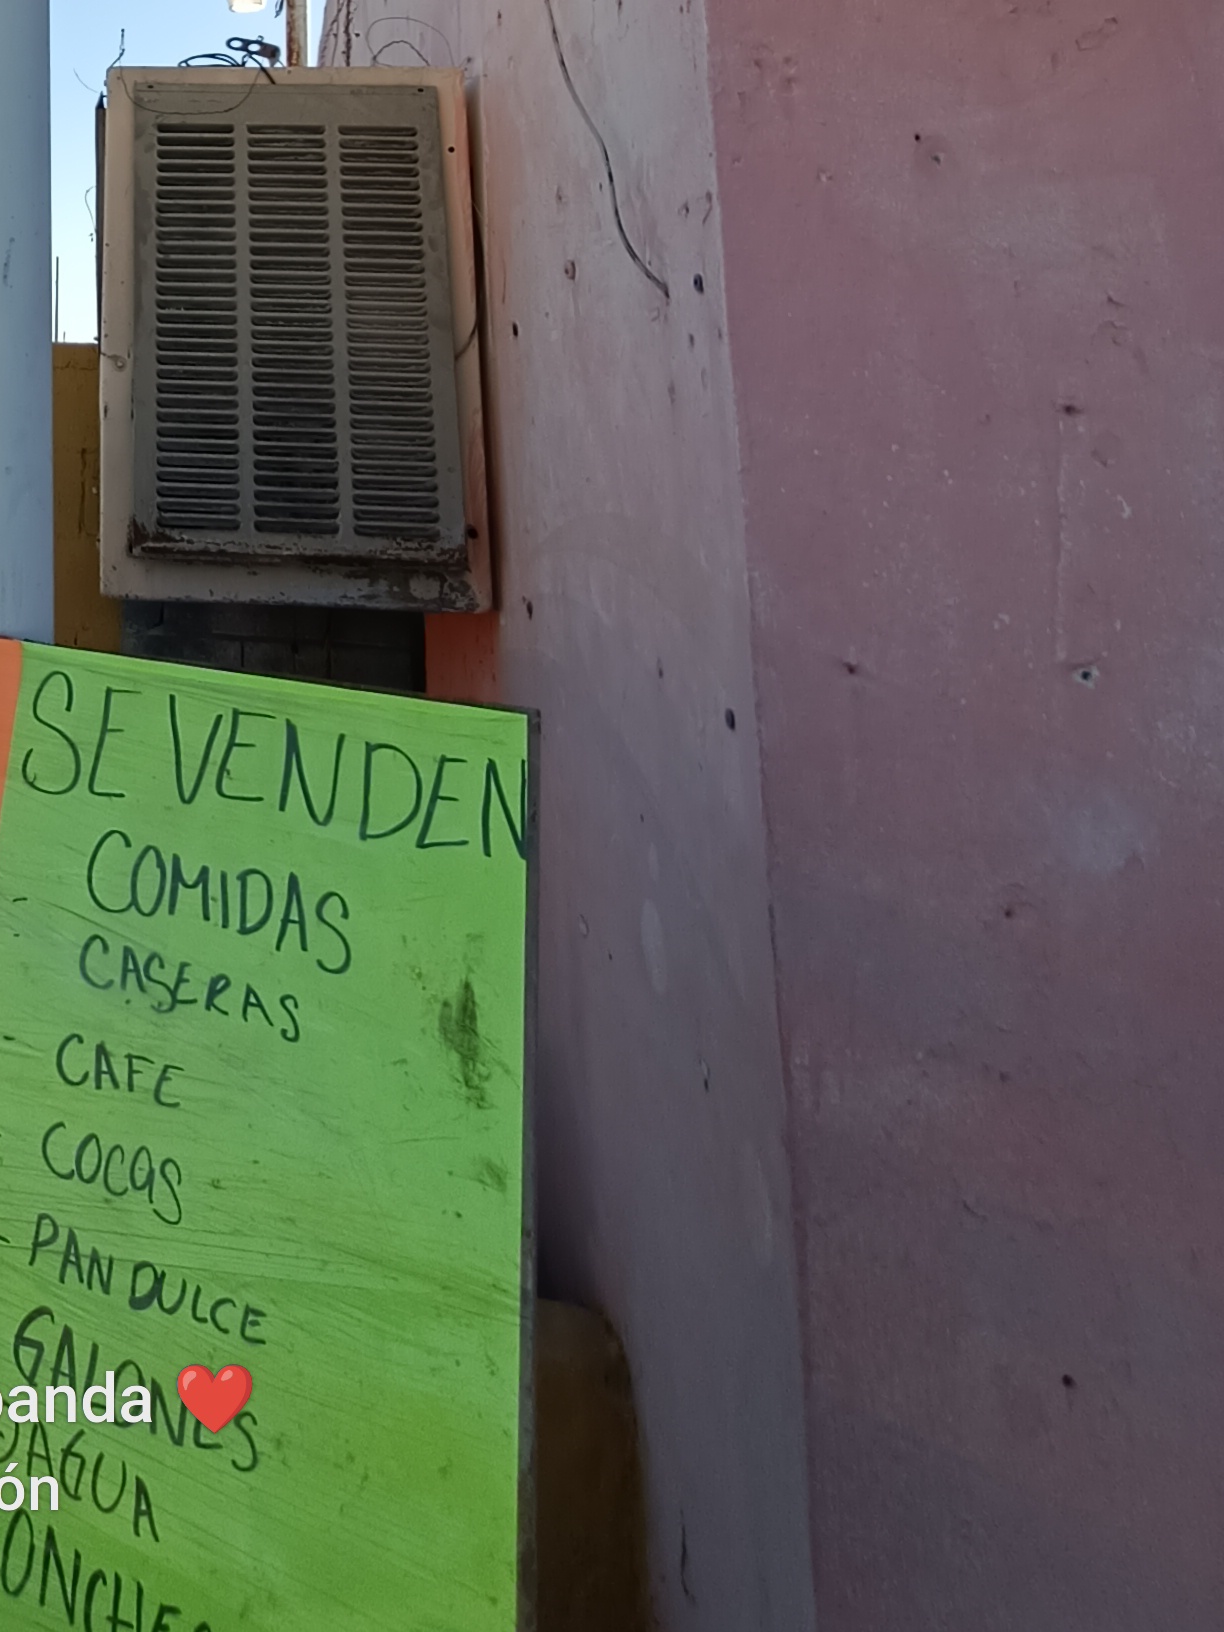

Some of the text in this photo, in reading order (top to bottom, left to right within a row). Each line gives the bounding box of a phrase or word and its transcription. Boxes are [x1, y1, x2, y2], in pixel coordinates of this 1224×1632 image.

[21, 670, 529, 862] SE VENDEN
[86, 829, 352, 975] COMIDAS
[79, 934, 301, 1044] CASERAS
[56, 1033, 185, 1108] CAFE
[28, 1212, 268, 1346] PAN DULCE
